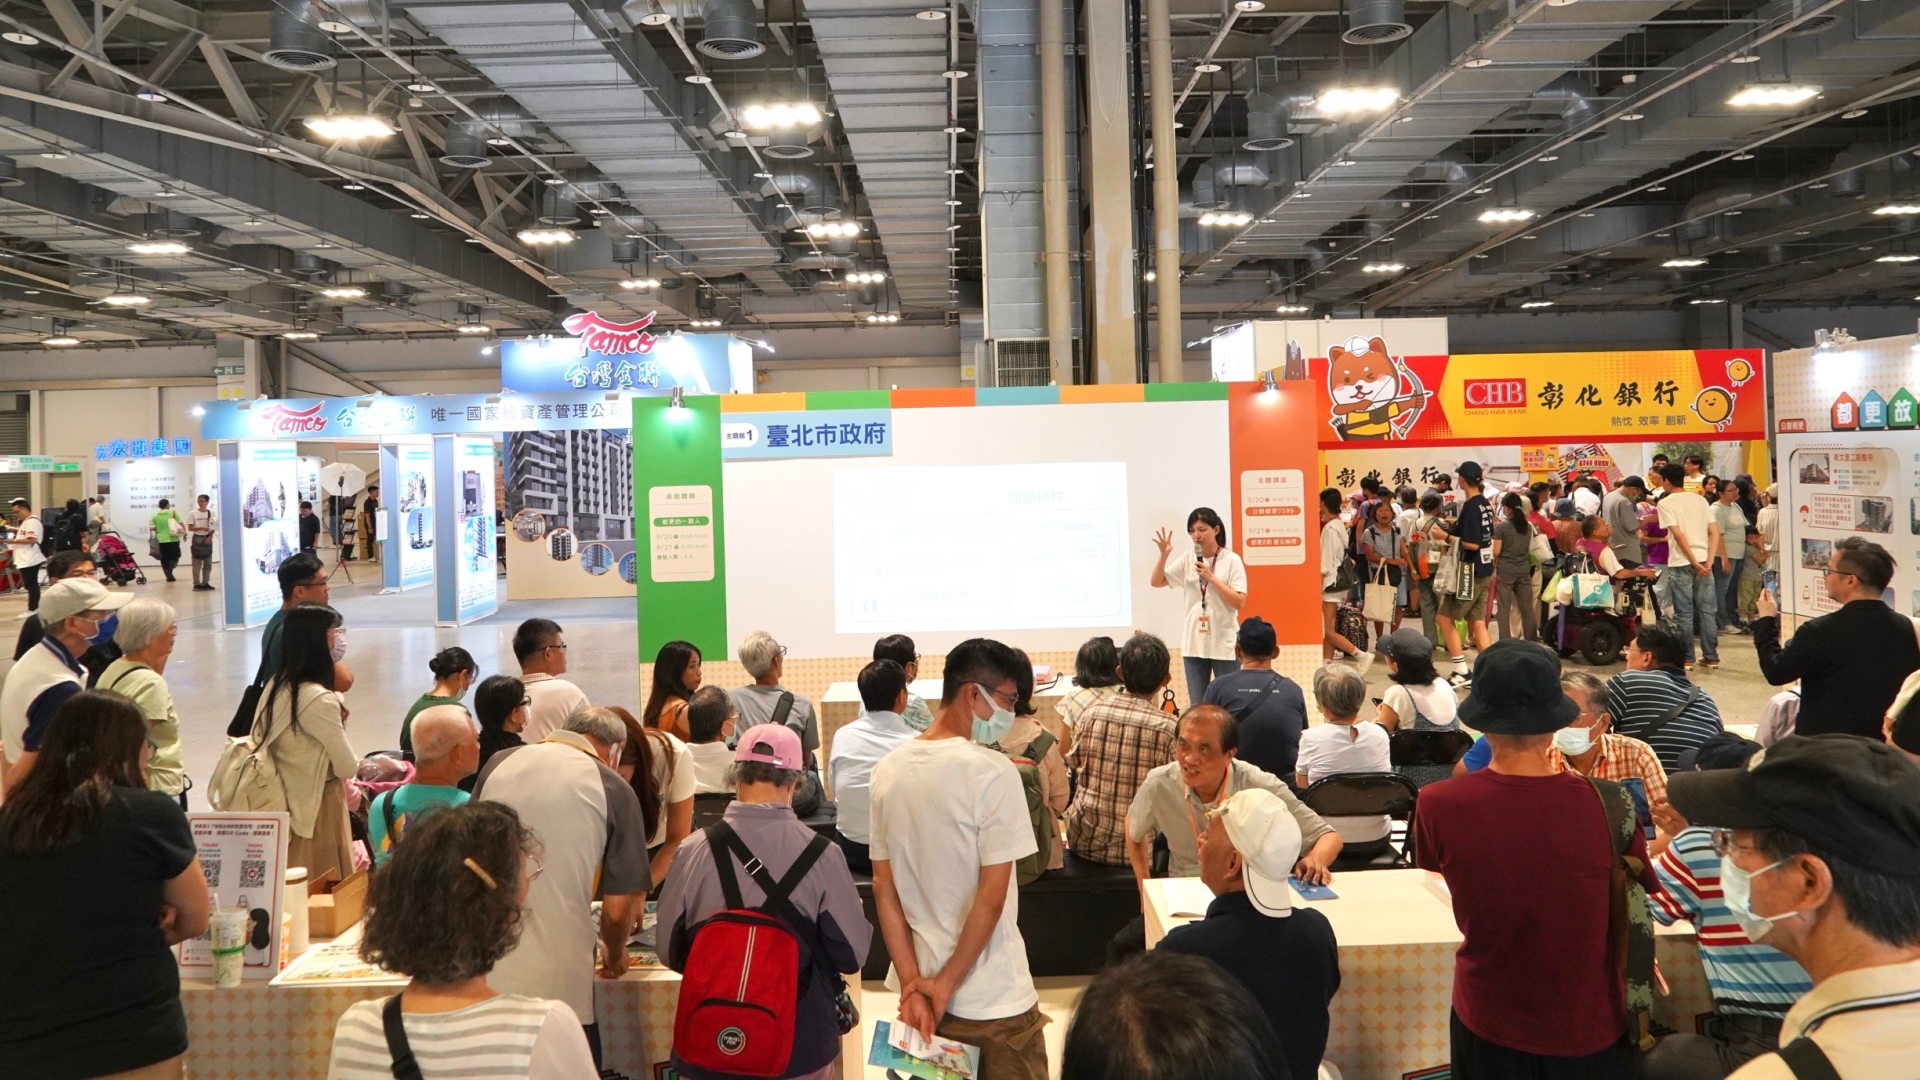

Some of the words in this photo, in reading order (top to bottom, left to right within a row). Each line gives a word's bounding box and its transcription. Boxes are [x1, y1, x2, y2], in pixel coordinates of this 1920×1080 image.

[564, 360, 661, 390] 台灣金聯
[1465, 382, 1524, 406] CHB
[1537, 380, 1680, 410] 彰化銀行
[430, 403, 624, 422] 唯一國家級資產管理公司
[1611, 416, 1633, 427] 熱忱
[1638, 416, 1660, 426] 效率
[1665, 415, 1687, 425] 創新
[1836, 399, 1913, 425] 都更故
[726, 432, 746, 441] 主題館
[746, 429, 754, 442] 1
[766, 421, 886, 448] 臺北市政府
[1008, 490, 1066, 505] 回饋條件
[1461, 575, 1471, 597] Roots
